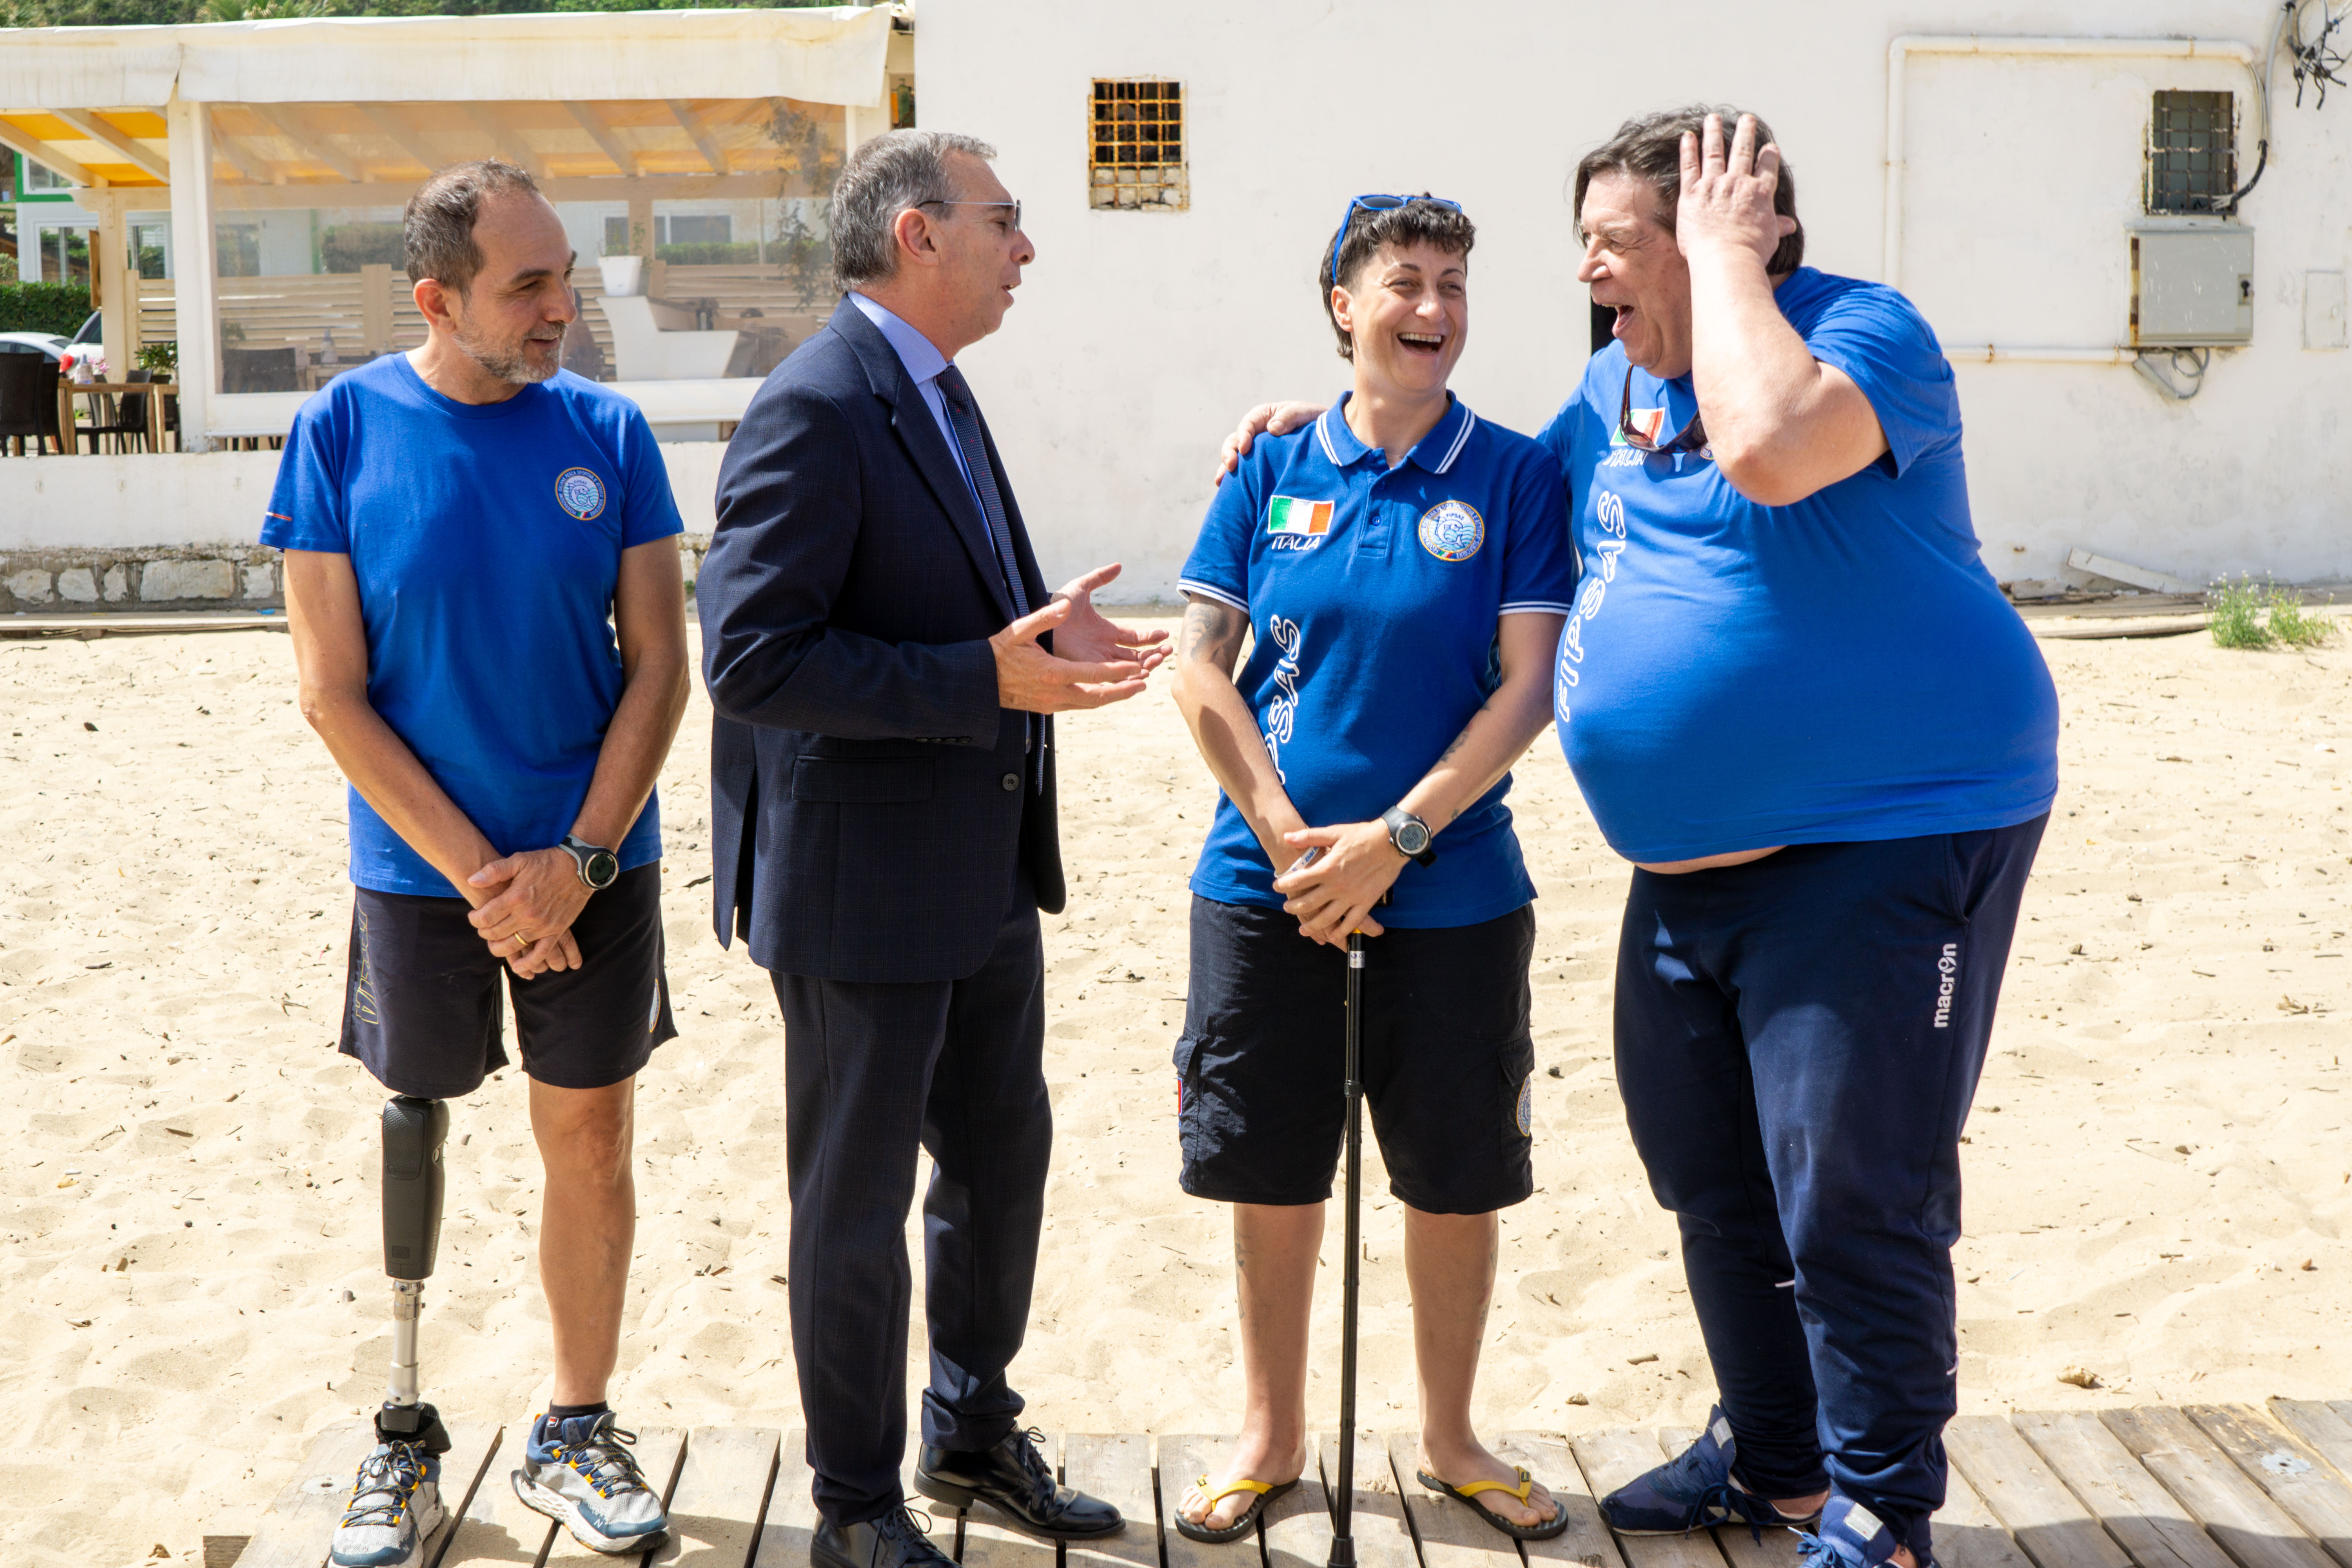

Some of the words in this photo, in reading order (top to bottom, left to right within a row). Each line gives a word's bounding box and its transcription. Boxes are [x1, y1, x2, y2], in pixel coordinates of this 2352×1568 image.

[1602, 449, 1648, 467] ITALIA
[1271, 535, 1320, 550] ITALIA
[1558, 490, 1626, 722] FIPSAS
[1934, 943, 1957, 1028] macron
